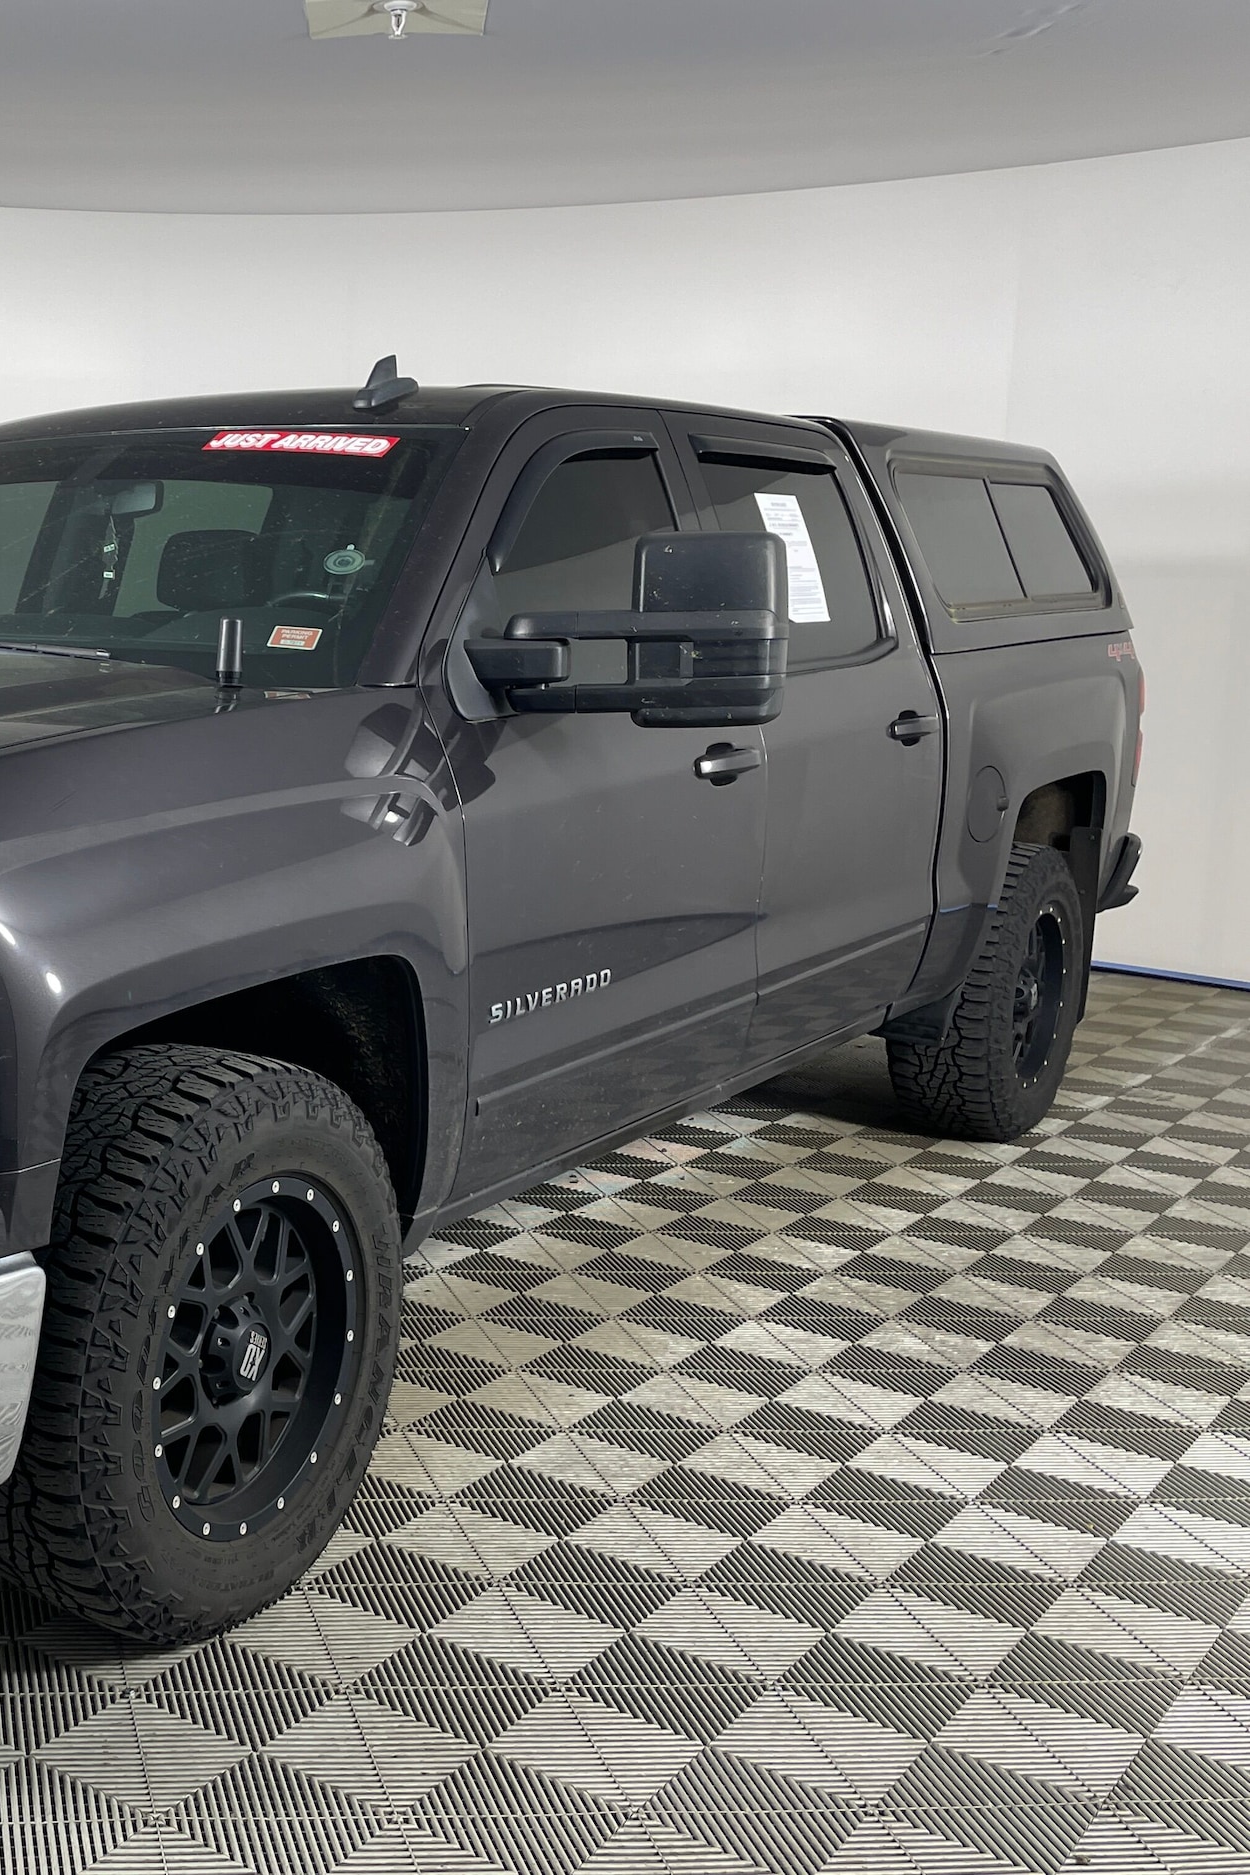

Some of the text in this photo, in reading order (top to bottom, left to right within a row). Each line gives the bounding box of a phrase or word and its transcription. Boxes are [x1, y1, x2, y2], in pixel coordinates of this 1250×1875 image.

[209, 433, 391, 454] JUST ARRIVED
[489, 968, 612, 1024] SILVERADO
[239, 1343, 266, 1381] XD
